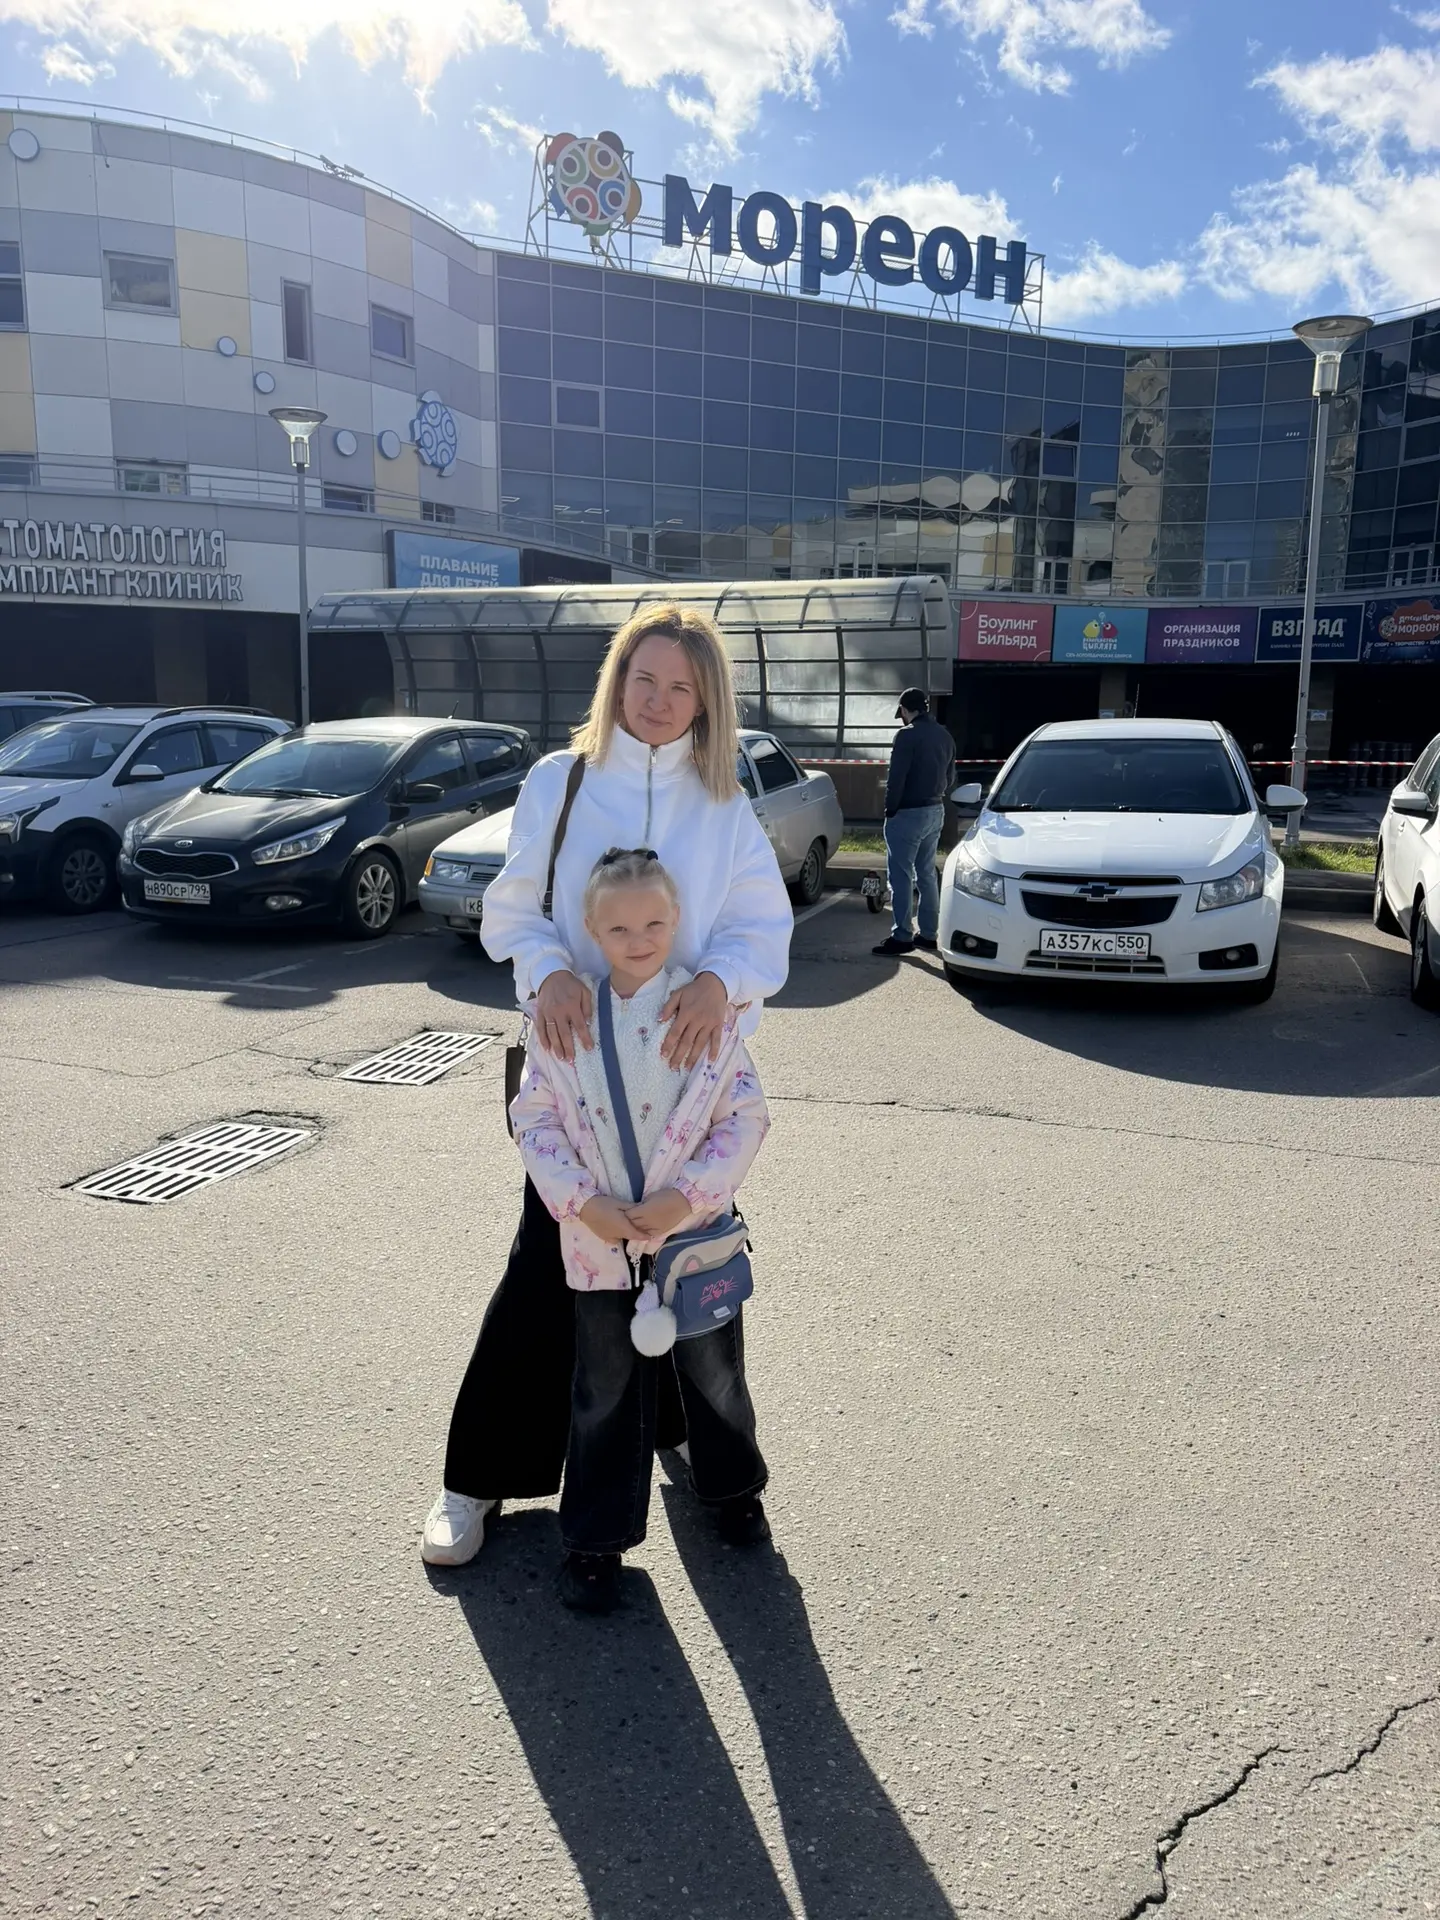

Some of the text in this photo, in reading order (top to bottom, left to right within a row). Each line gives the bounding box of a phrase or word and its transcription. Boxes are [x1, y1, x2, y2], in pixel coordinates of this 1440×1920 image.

[0, 518, 227, 567] ТОМАТОЛОГИЯ
[420, 554, 499, 577] ПЛАВАНИЕ
[124, 569, 243, 601] КЛИНИК
[420, 572, 499, 588] ДЛЯ ДЕТЕЙ
[978, 614, 1038, 632] Боулинг
[1163, 624, 1241, 634] ОРГАНИЗАЦИЯ
[977, 631, 1037, 649] Бильярд
[1163, 638, 1240, 648] ПРАЗДНИКОВ
[1117, 936, 1144, 949] 550
